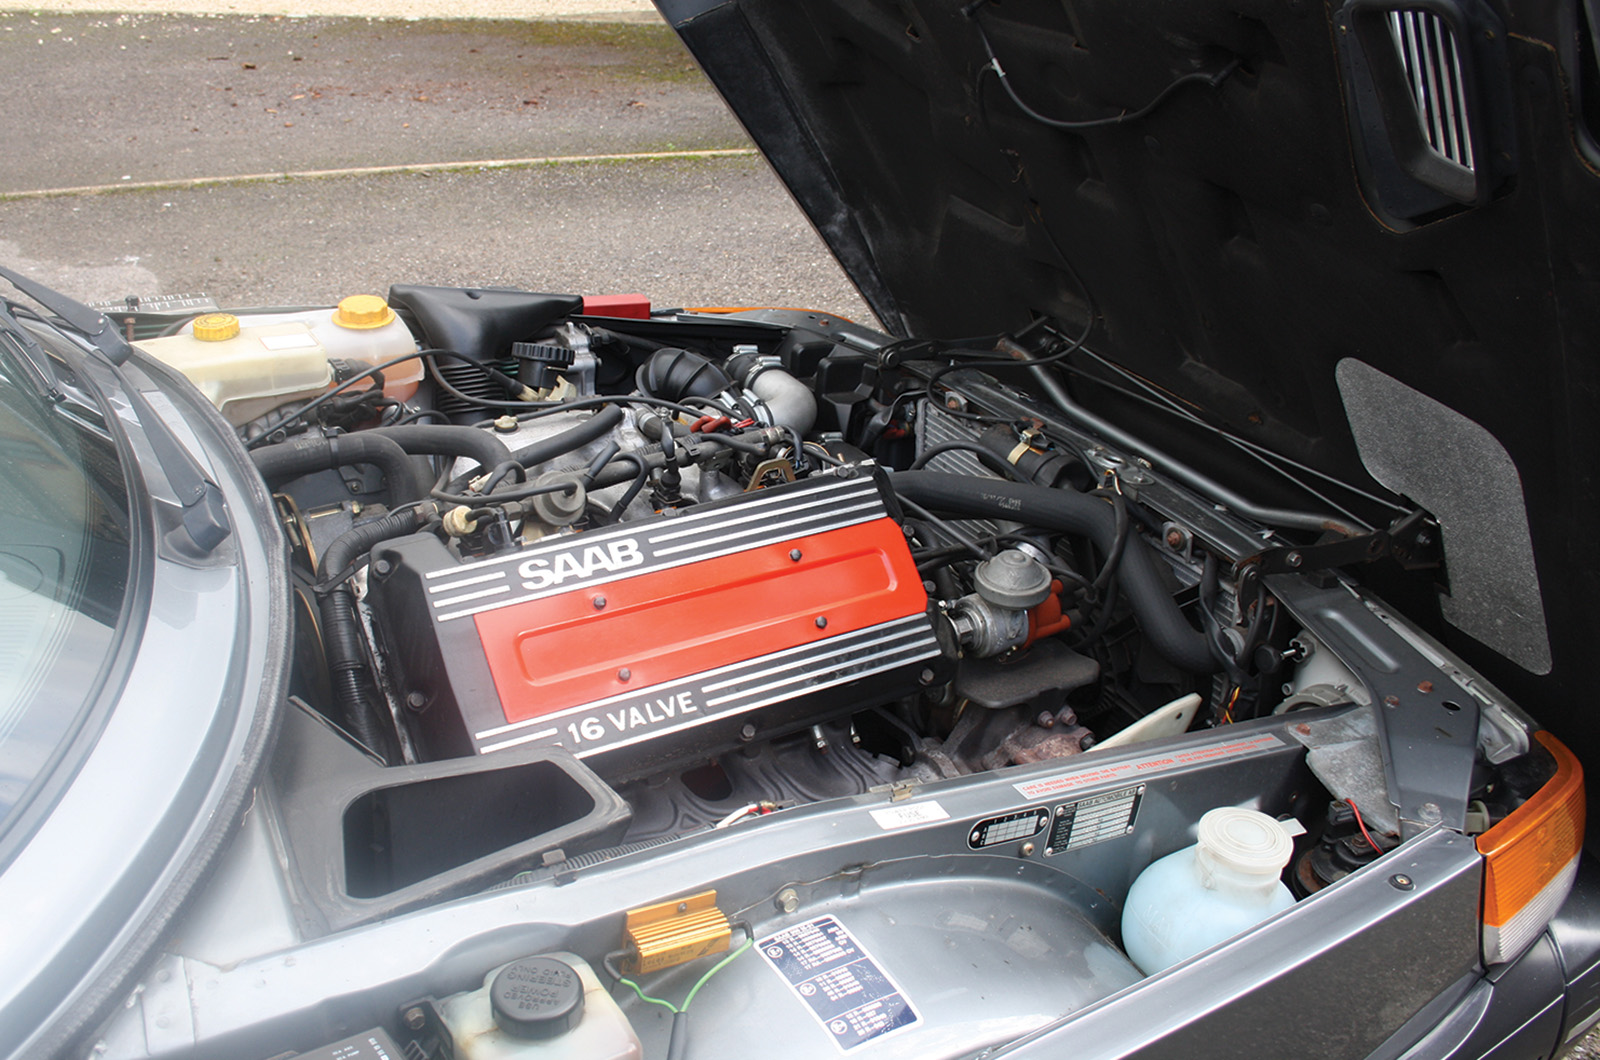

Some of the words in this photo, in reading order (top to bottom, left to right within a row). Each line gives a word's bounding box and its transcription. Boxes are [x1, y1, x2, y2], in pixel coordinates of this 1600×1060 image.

[518, 538, 644, 590] SAAB
[567, 716, 605, 744] 16
[606, 691, 698, 731] VALVE
[1135, 758, 1175, 770] ATTENTION
[511, 965, 538, 975] ONLY
[507, 971, 572, 988] STEERING
[510, 984, 559, 998] POWER
[503, 991, 560, 1006] APPROVED
[518, 1001, 540, 1011] USE
